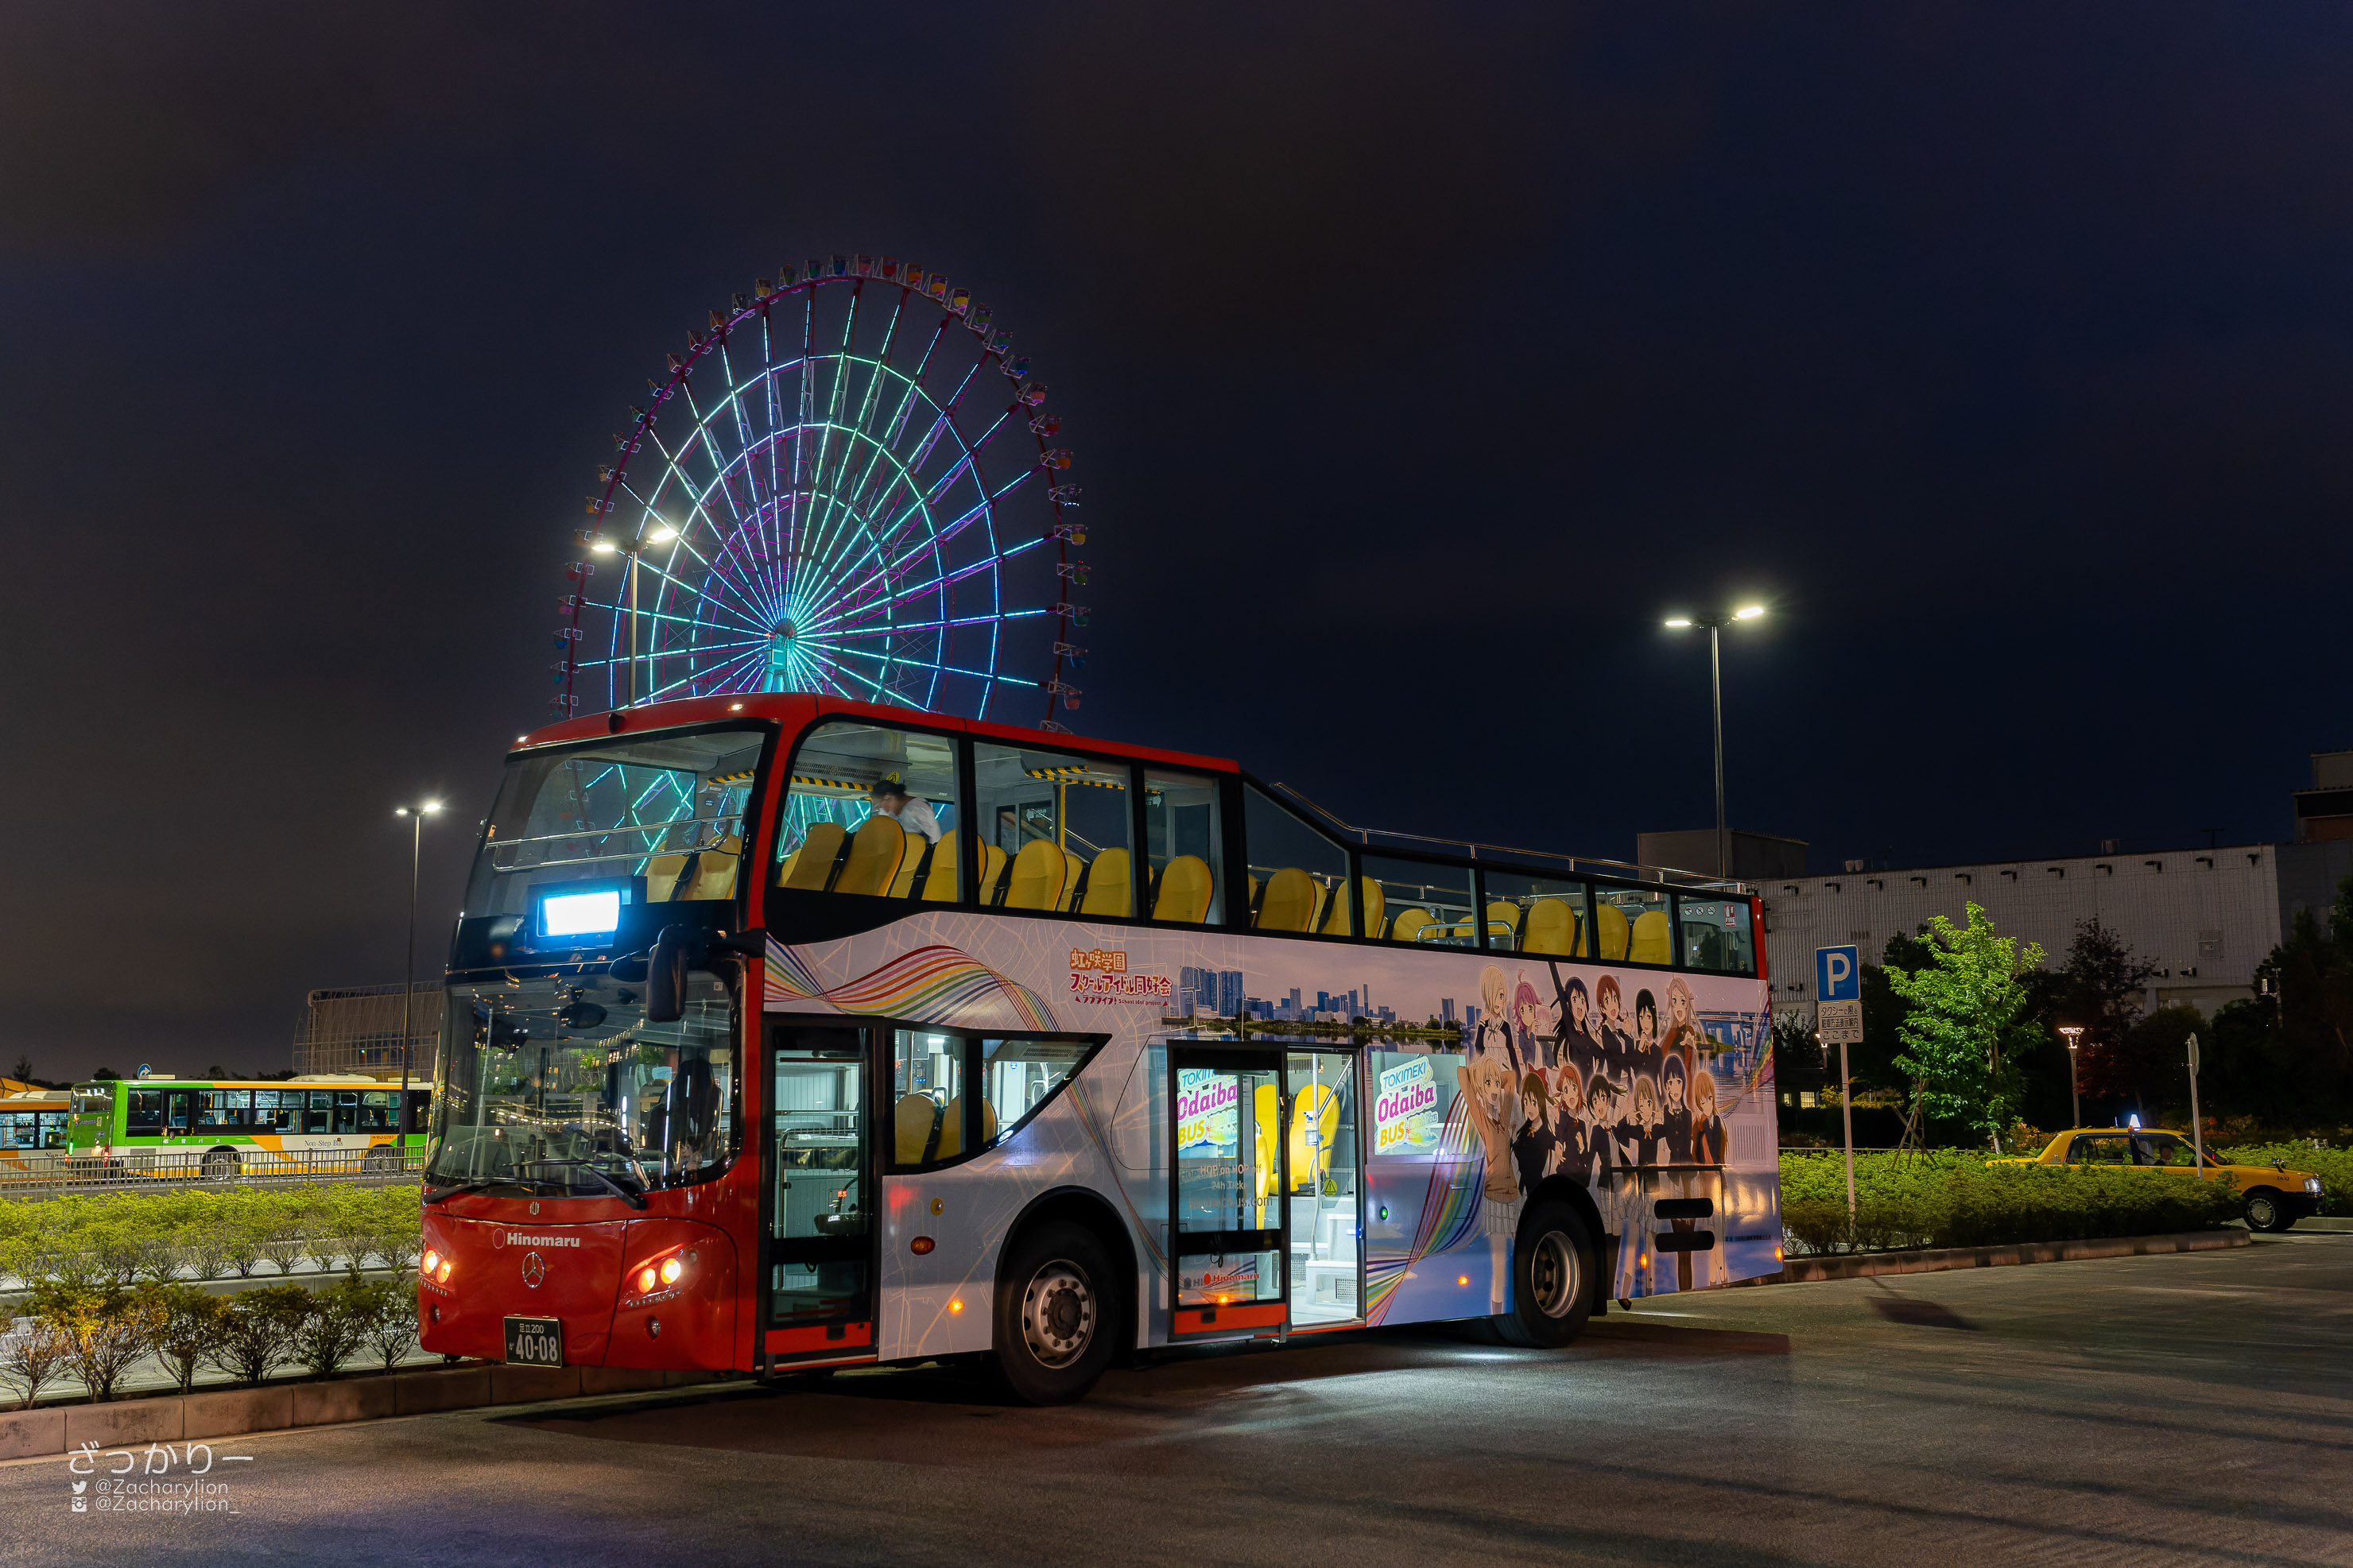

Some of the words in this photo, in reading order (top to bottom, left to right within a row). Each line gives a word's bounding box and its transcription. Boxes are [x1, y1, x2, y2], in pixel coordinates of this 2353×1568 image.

[1827, 953, 1851, 996] P
[1821, 1005, 1859, 1016] タクシーに限る
[1823, 1030, 1859, 1040] ここまで
[1383, 1061, 1426, 1090] TOKIMEKI
[1177, 1082, 1237, 1121] Odaiba
[1378, 1084, 1434, 1122] Odaiba
[1178, 1120, 1205, 1145] BUS
[1379, 1121, 1405, 1147] BUS
[506, 1232, 580, 1248] Hinomaru
[1212, 1273, 1259, 1283] Hinomaru
[531, 1324, 545, 1334] 200
[516, 1334, 558, 1362] 40-08
